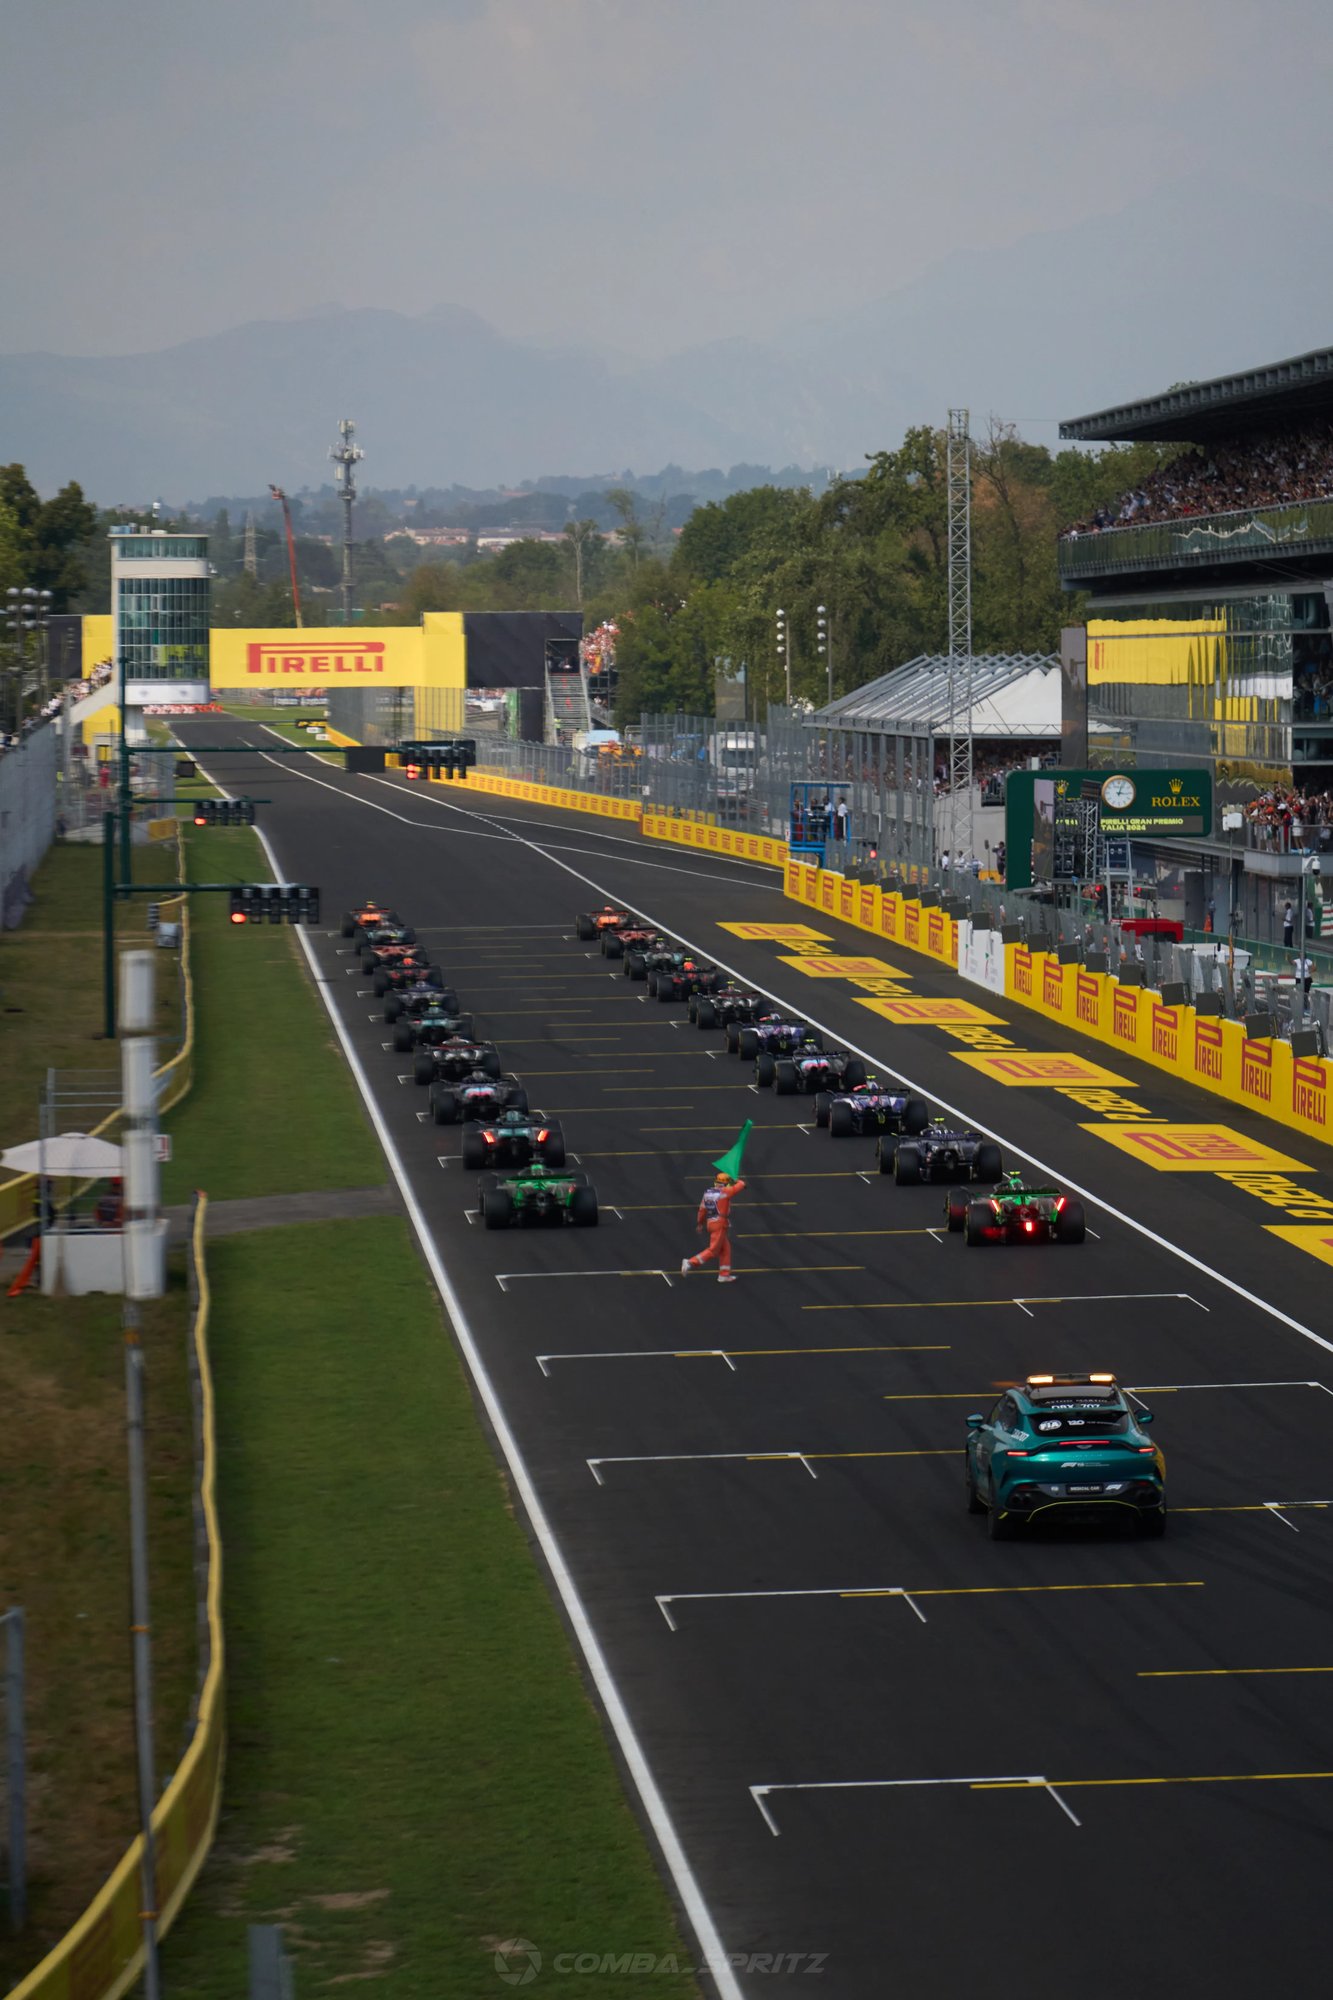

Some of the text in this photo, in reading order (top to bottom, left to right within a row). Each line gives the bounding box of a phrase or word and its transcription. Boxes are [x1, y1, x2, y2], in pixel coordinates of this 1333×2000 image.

[247, 642, 386, 673] PIRELLI
[1151, 797, 1200, 807] ROLEX
[1014, 947, 1032, 997] PIRELLI
[1043, 959, 1063, 1011] PIRELLI
[1077, 972, 1099, 1027] PIRELLI
[1113, 987, 1137, 1043] PIRELLI
[1152, 1003, 1178, 1061] PIRELLI
[1195, 1019, 1223, 1081] PIRELLI
[1241, 1037, 1272, 1103] PIRELLI
[1292, 1057, 1327, 1126] PIRELLI
[1122, 1132, 1268, 1161] PIRELLI
[1213, 1172, 1333, 1209] ZERO
